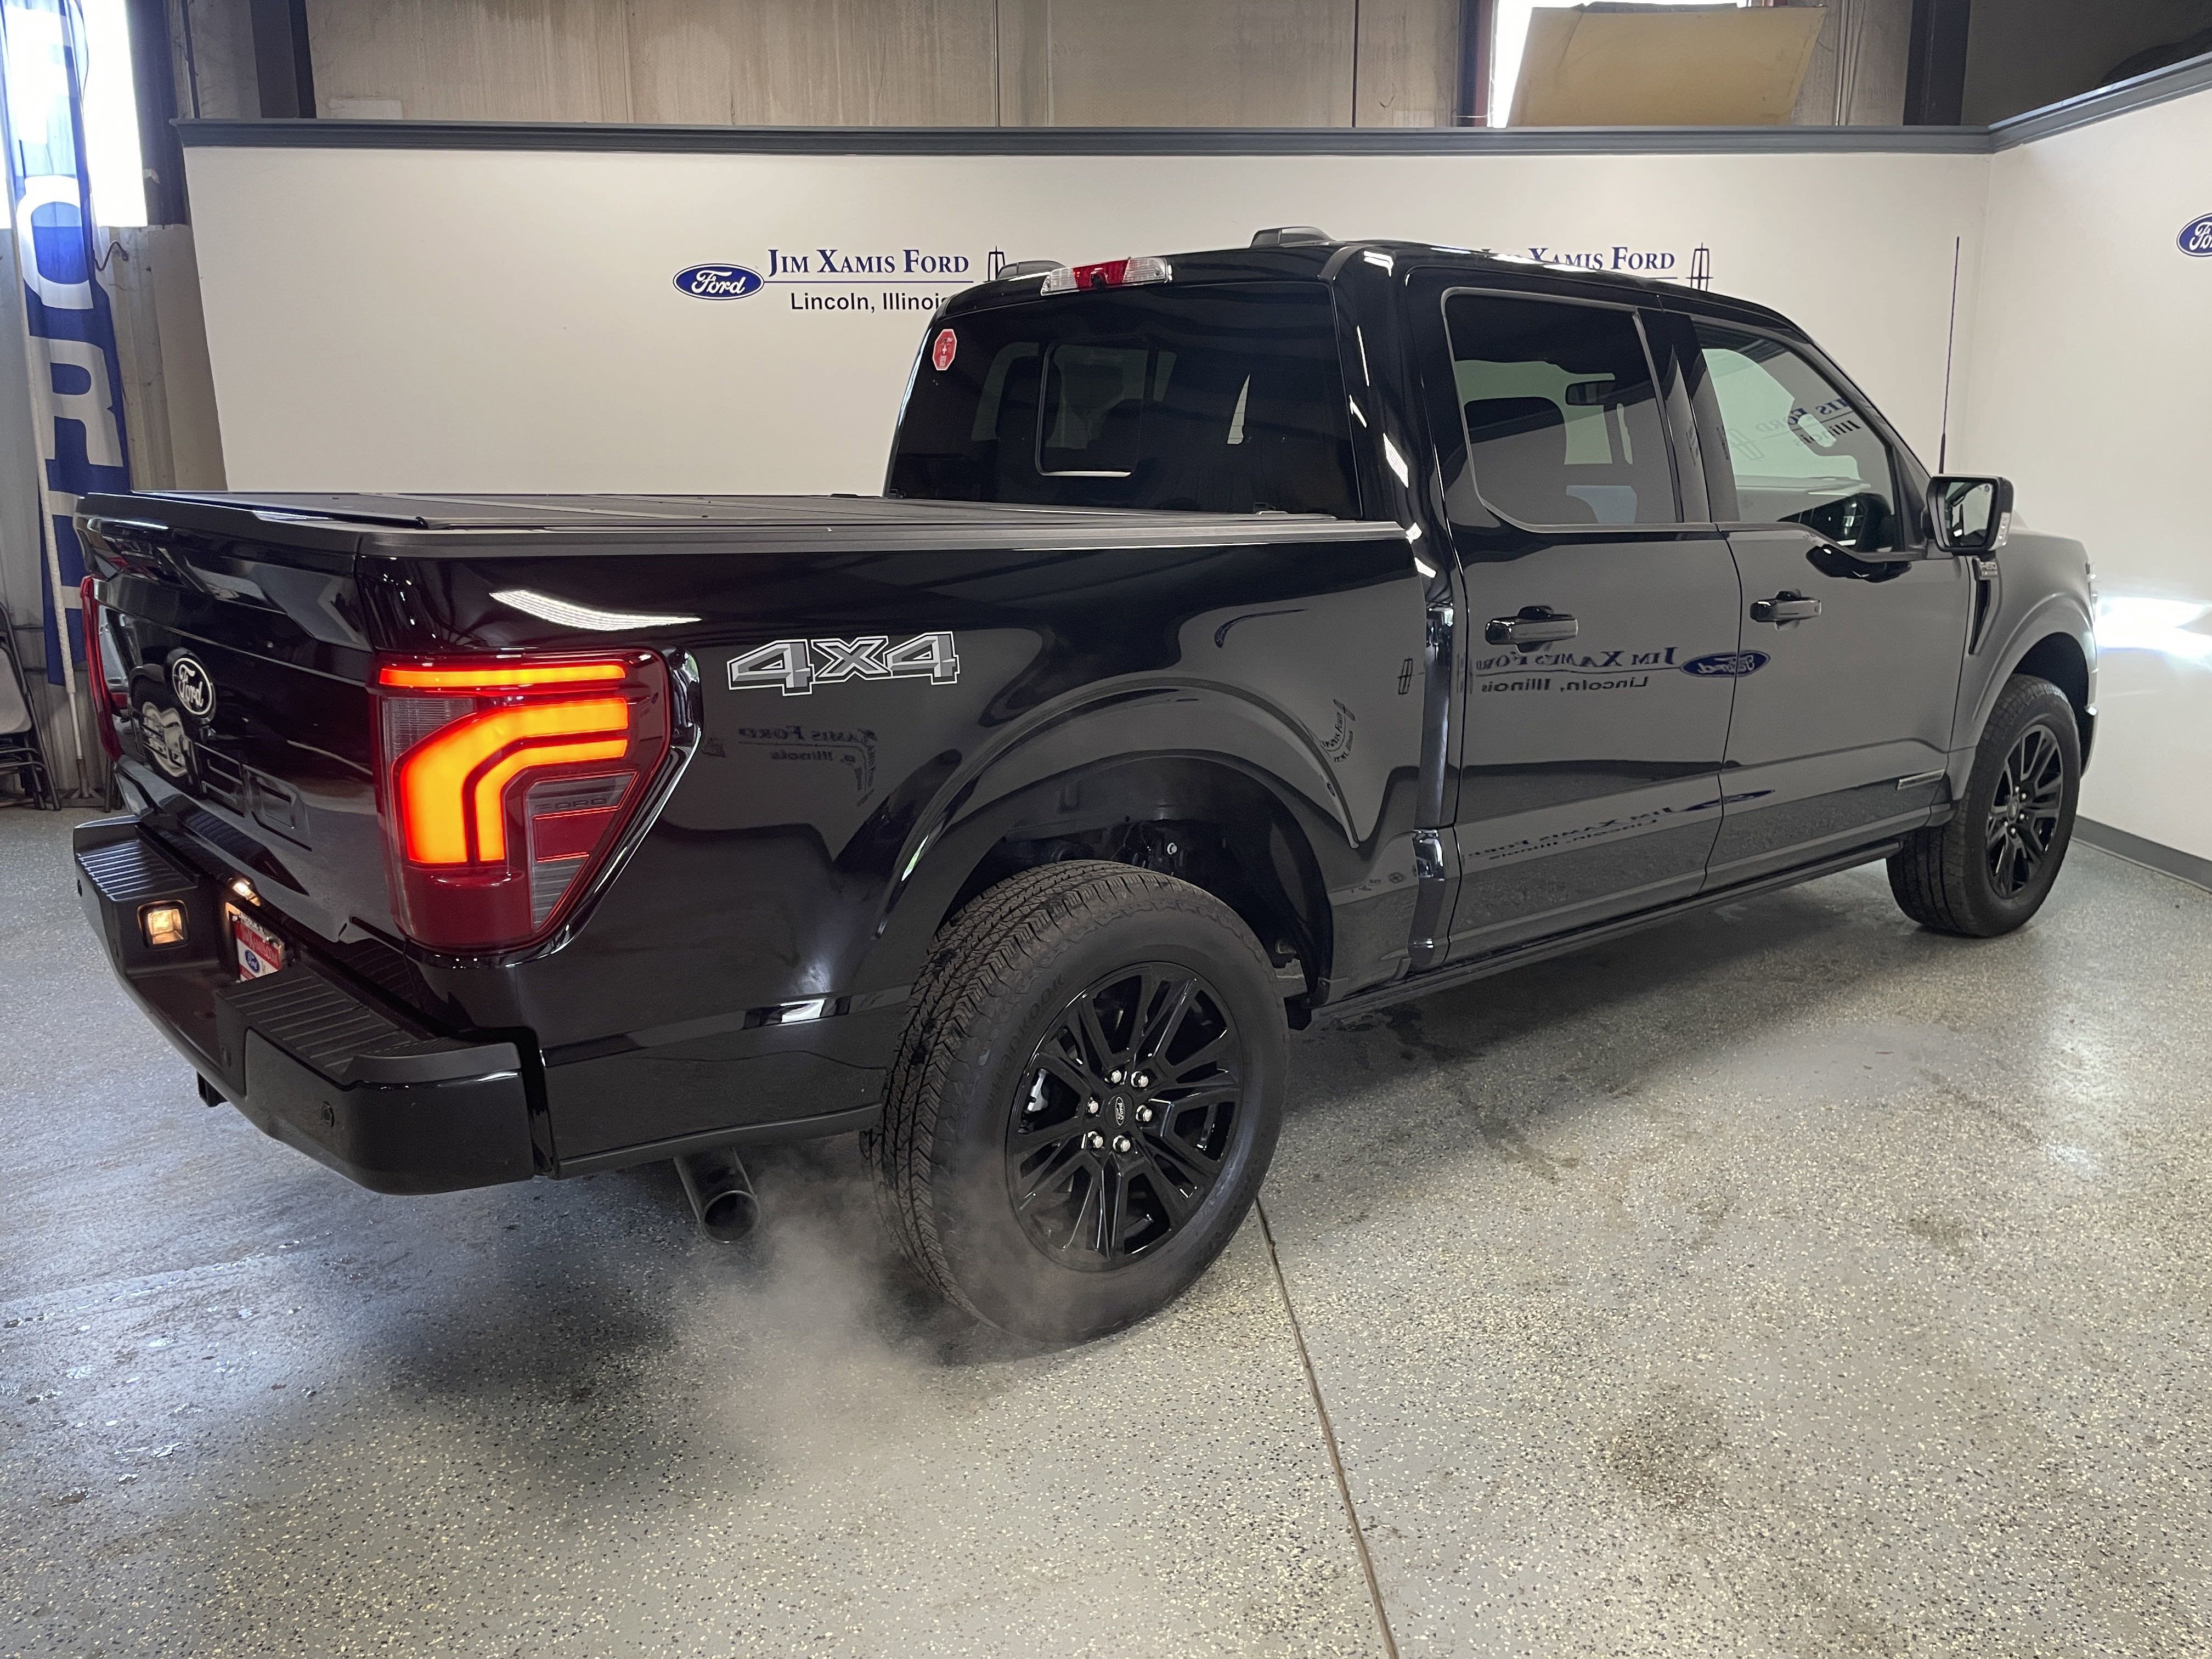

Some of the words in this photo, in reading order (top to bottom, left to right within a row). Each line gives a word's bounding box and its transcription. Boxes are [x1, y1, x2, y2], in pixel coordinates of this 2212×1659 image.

[768, 249, 810, 277] JIM
[816, 249, 895, 273] XAMIS
[902, 249, 969, 273] FORD
[1611, 246, 1675, 270] FORD
[691, 270, 746, 294] Ford
[791, 292, 875, 313] Lincoln,
[883, 292, 948, 311] Illinoi
